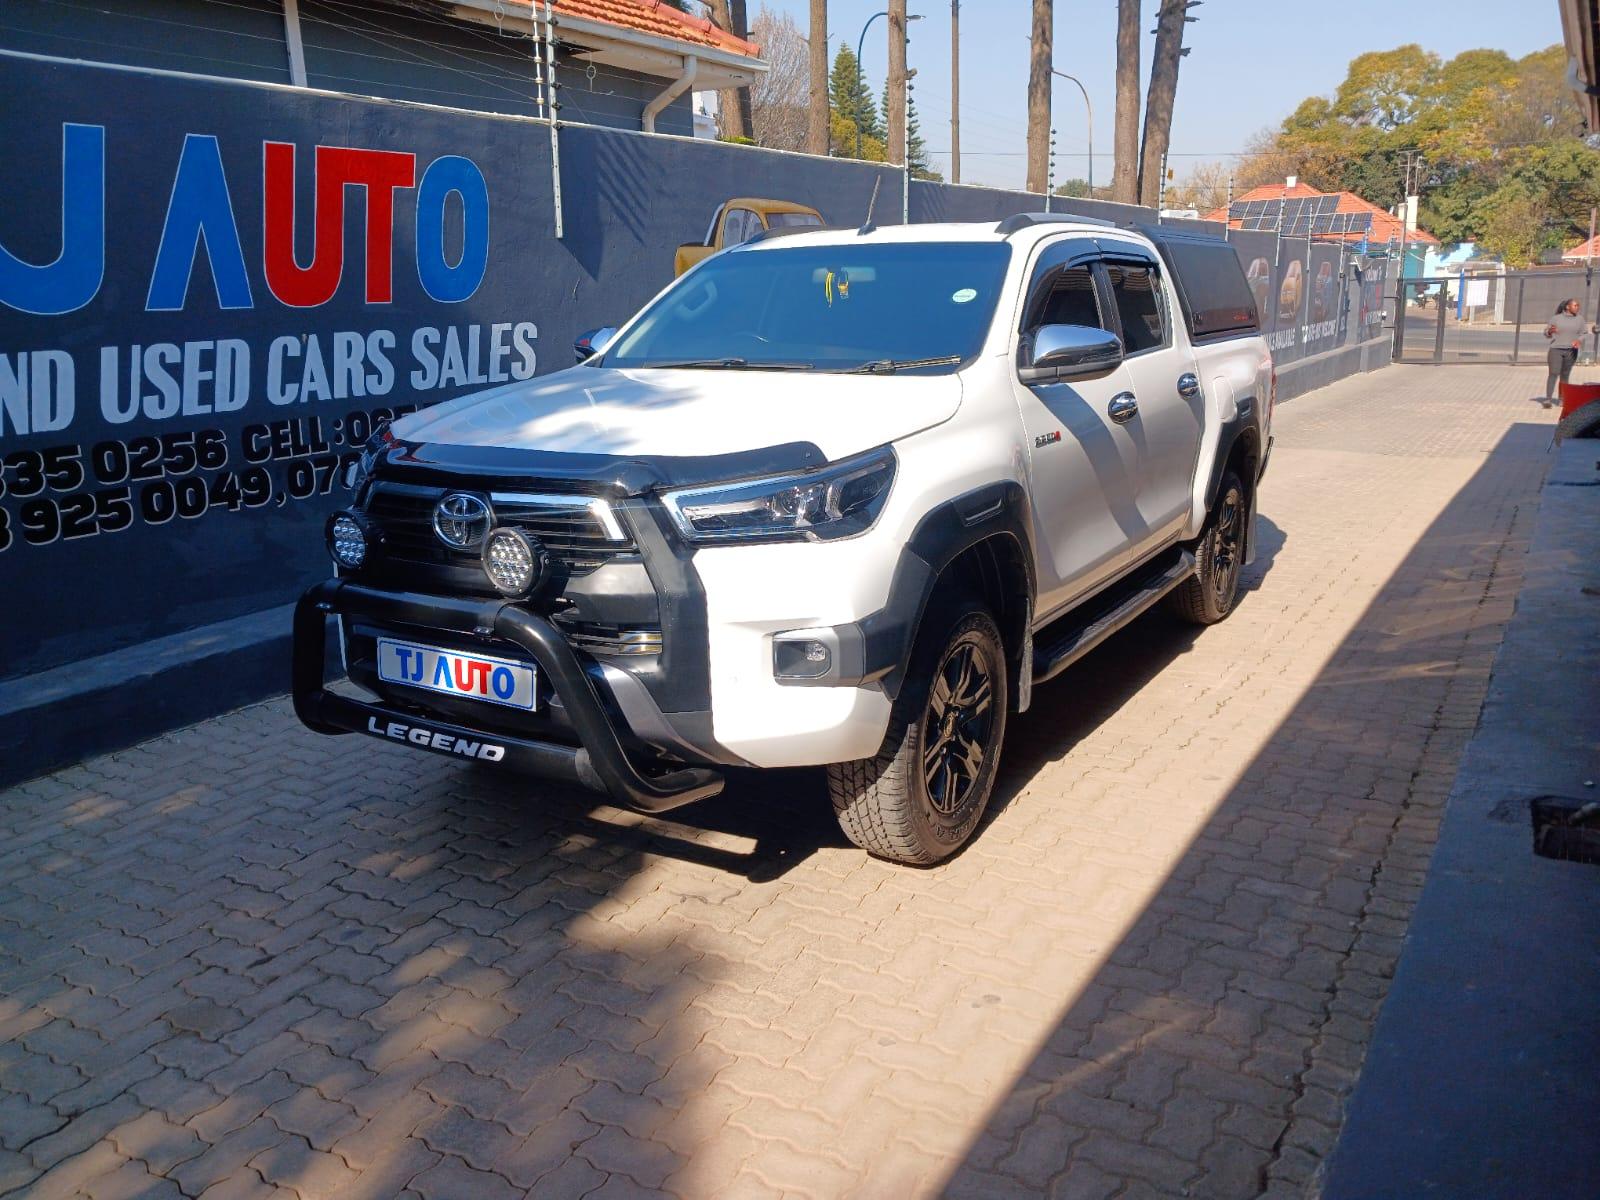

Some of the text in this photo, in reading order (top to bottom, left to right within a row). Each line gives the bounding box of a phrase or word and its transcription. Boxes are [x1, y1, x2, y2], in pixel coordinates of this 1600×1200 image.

[144, 132, 490, 312] AUTO
[100, 338, 251, 425] USED
[266, 329, 396, 406] CARS
[410, 321, 538, 391] SALES
[0, 444, 84, 498] 35
[92, 429, 228, 484] 0256
[20, 486, 134, 546] 925
[395, 647, 515, 700] TJ AUTO
[367, 716, 505, 762] LEGEND
